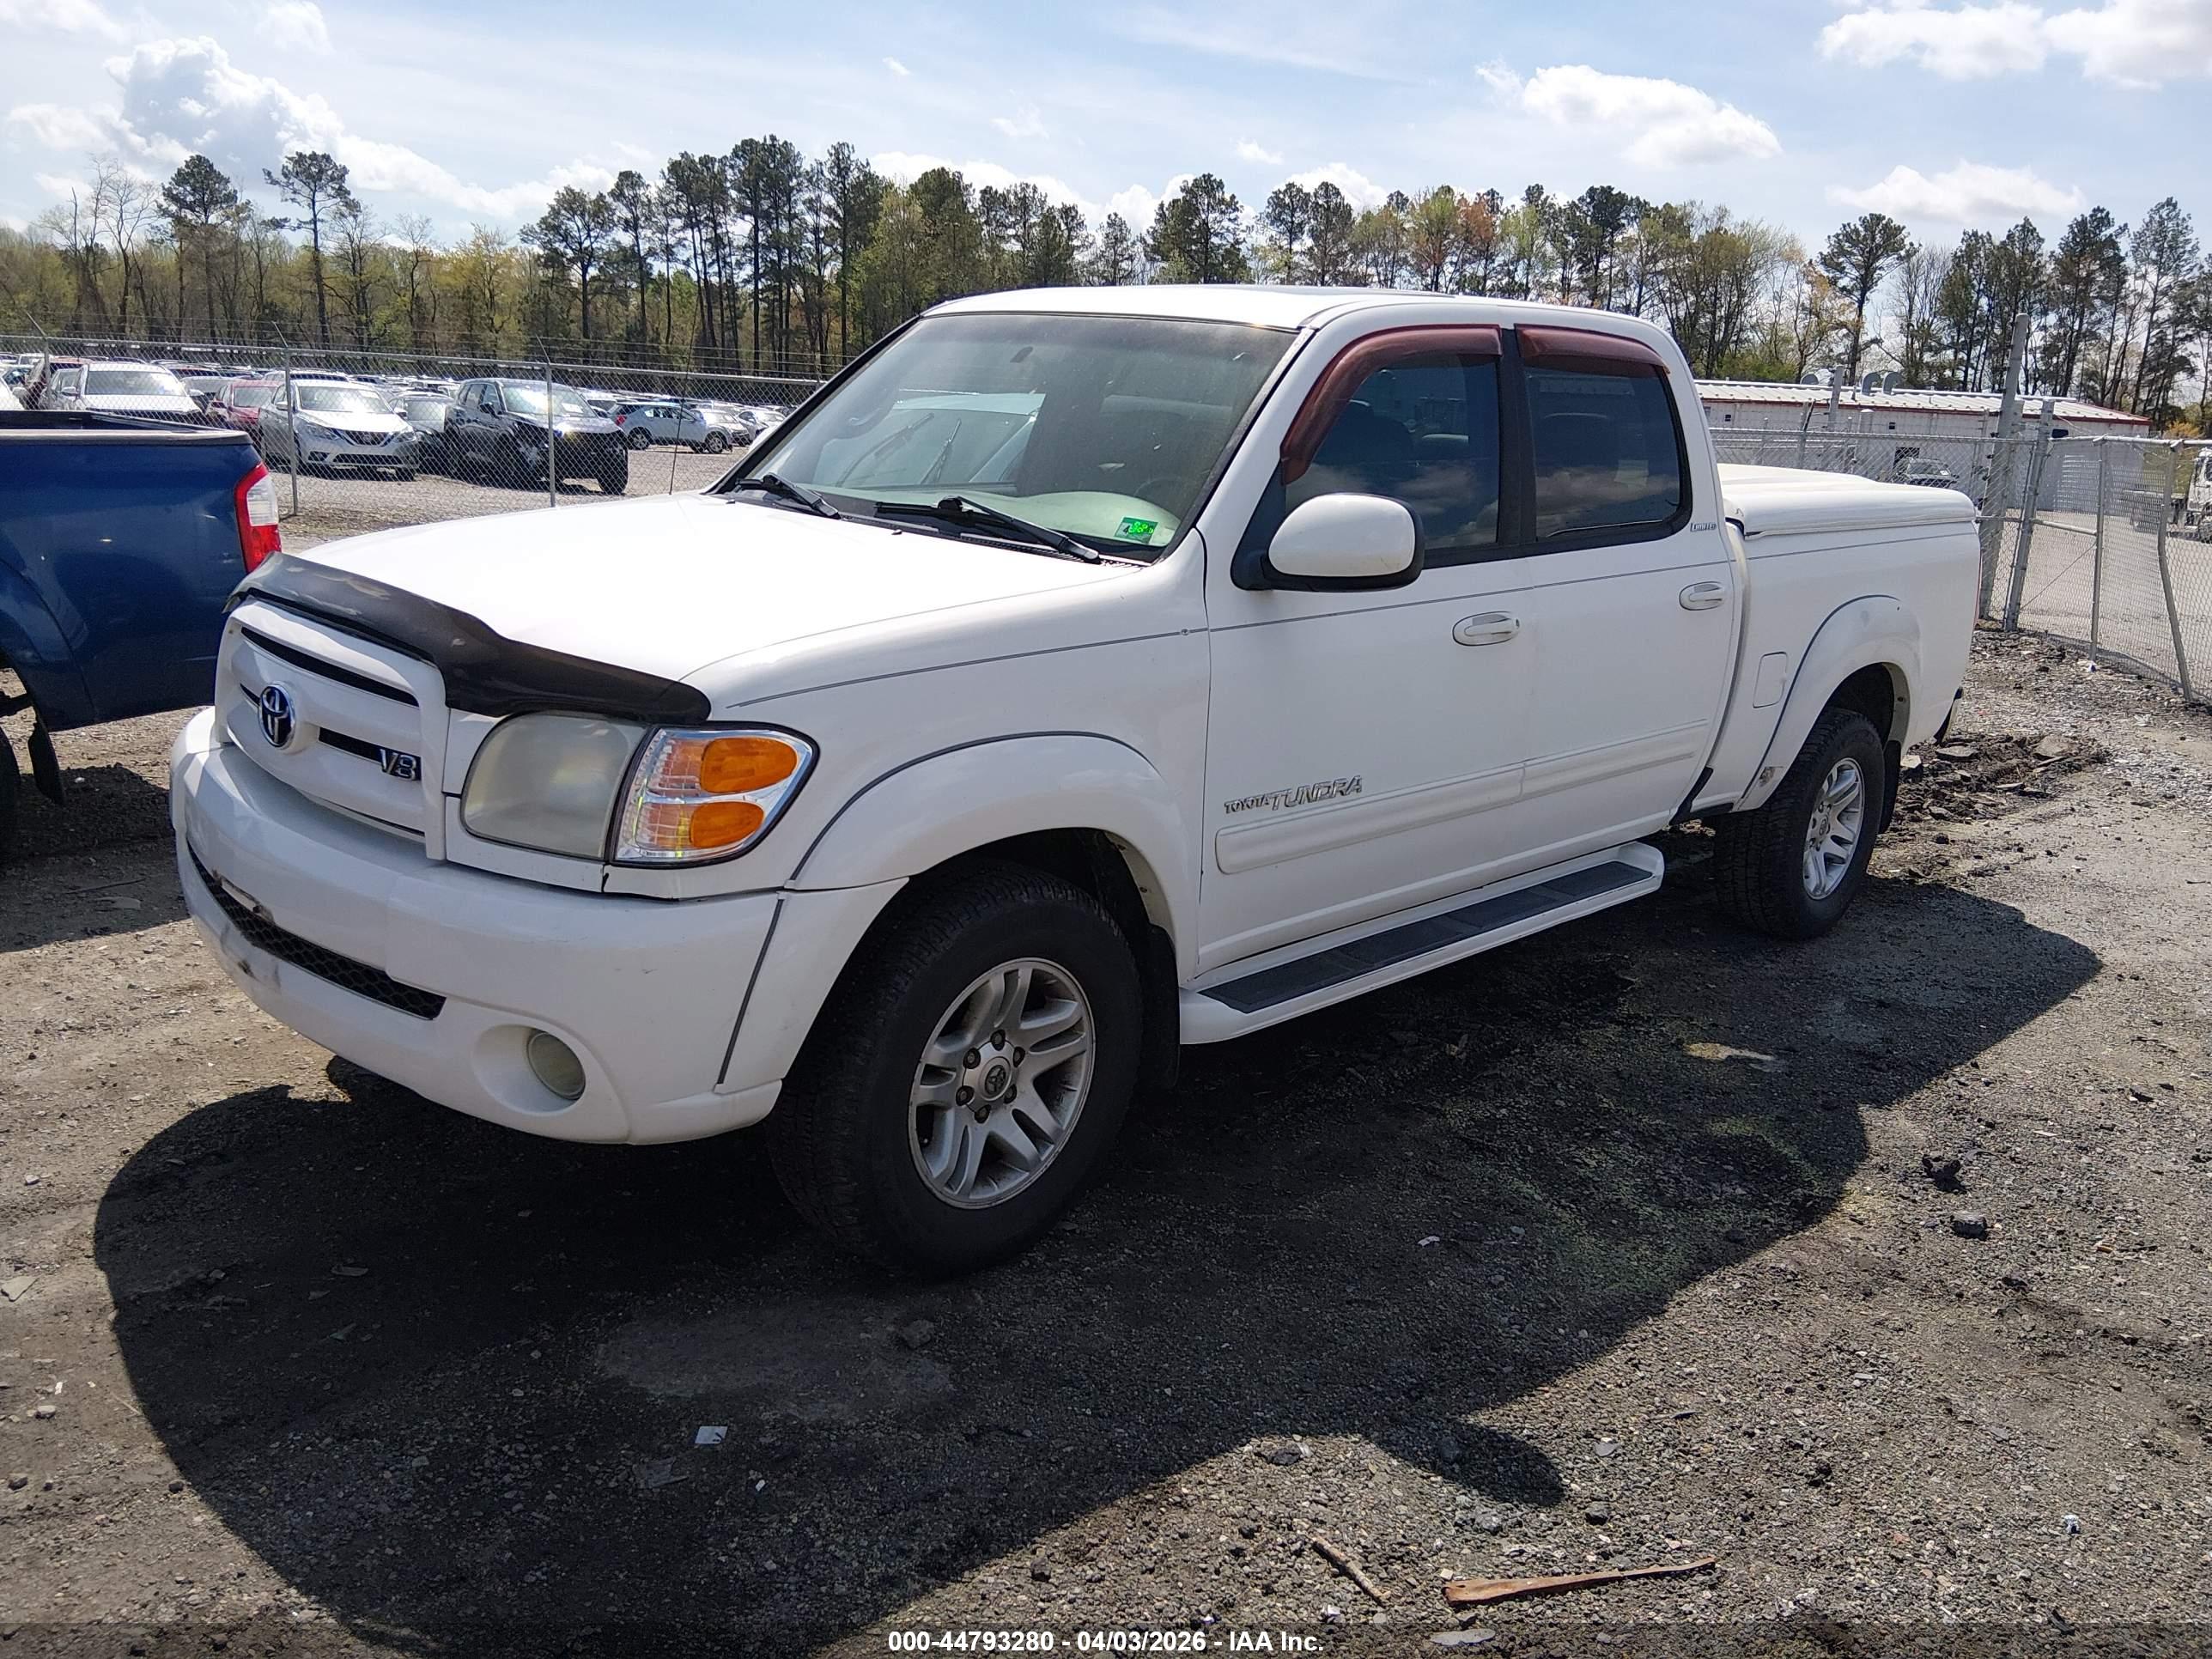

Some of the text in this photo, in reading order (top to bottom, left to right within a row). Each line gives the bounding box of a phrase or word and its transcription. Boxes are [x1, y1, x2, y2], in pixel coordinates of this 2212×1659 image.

[380, 748, 417, 781] V8
[1224, 775, 1363, 813] TOYOTA TUNDRA
